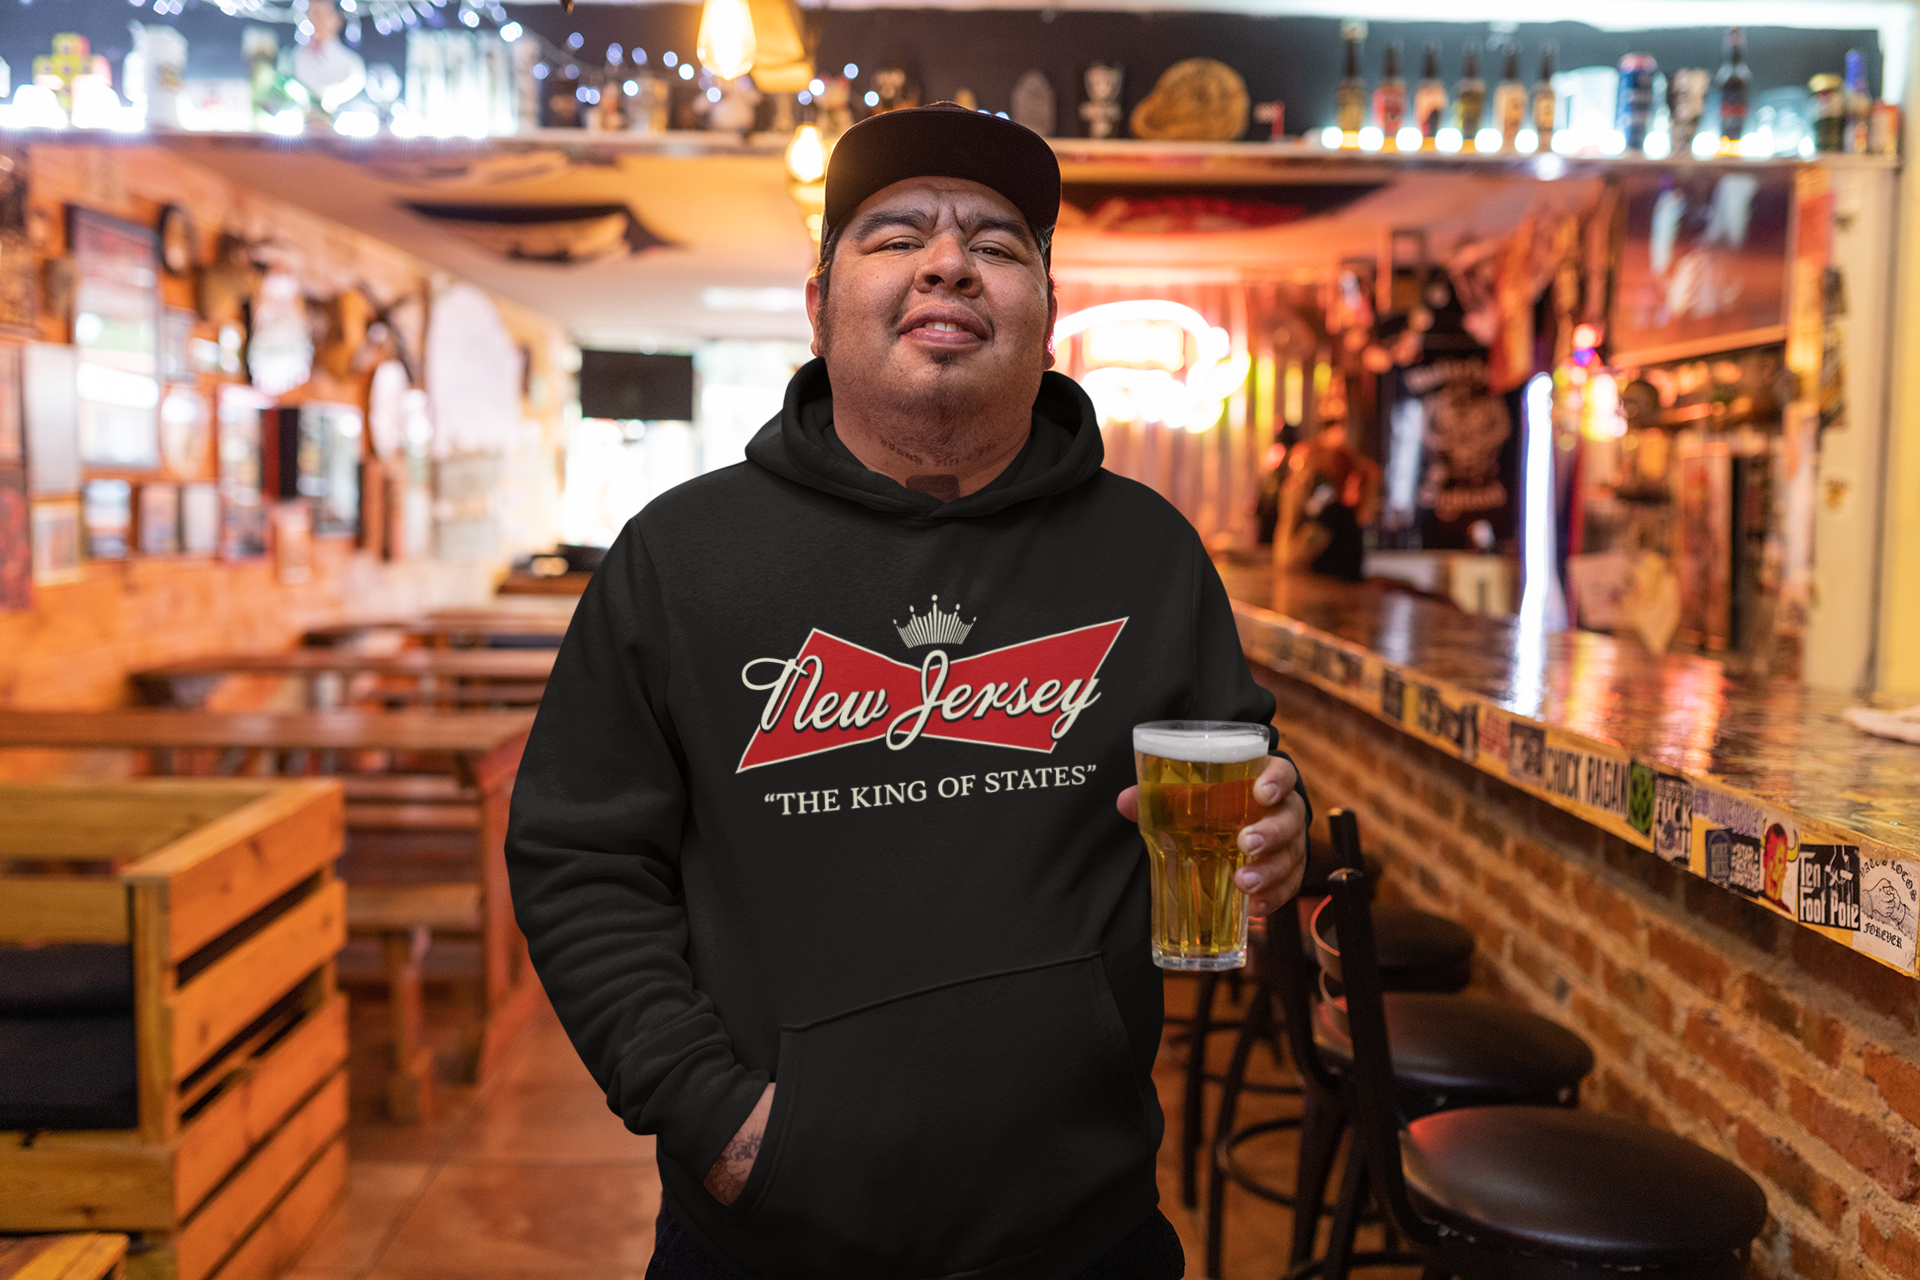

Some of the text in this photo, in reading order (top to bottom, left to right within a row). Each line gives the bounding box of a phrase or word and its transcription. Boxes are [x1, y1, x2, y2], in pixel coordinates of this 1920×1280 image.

[742, 649, 1102, 751] New Jersey
[850, 780, 927, 810] KING
[937, 775, 976, 798] OF
[1799, 851, 1821, 888] Ten
[1891, 859, 1917, 902] LOCOS
[1800, 887, 1859, 929] Foot Pole
[1863, 922, 1903, 949] FOREVER
